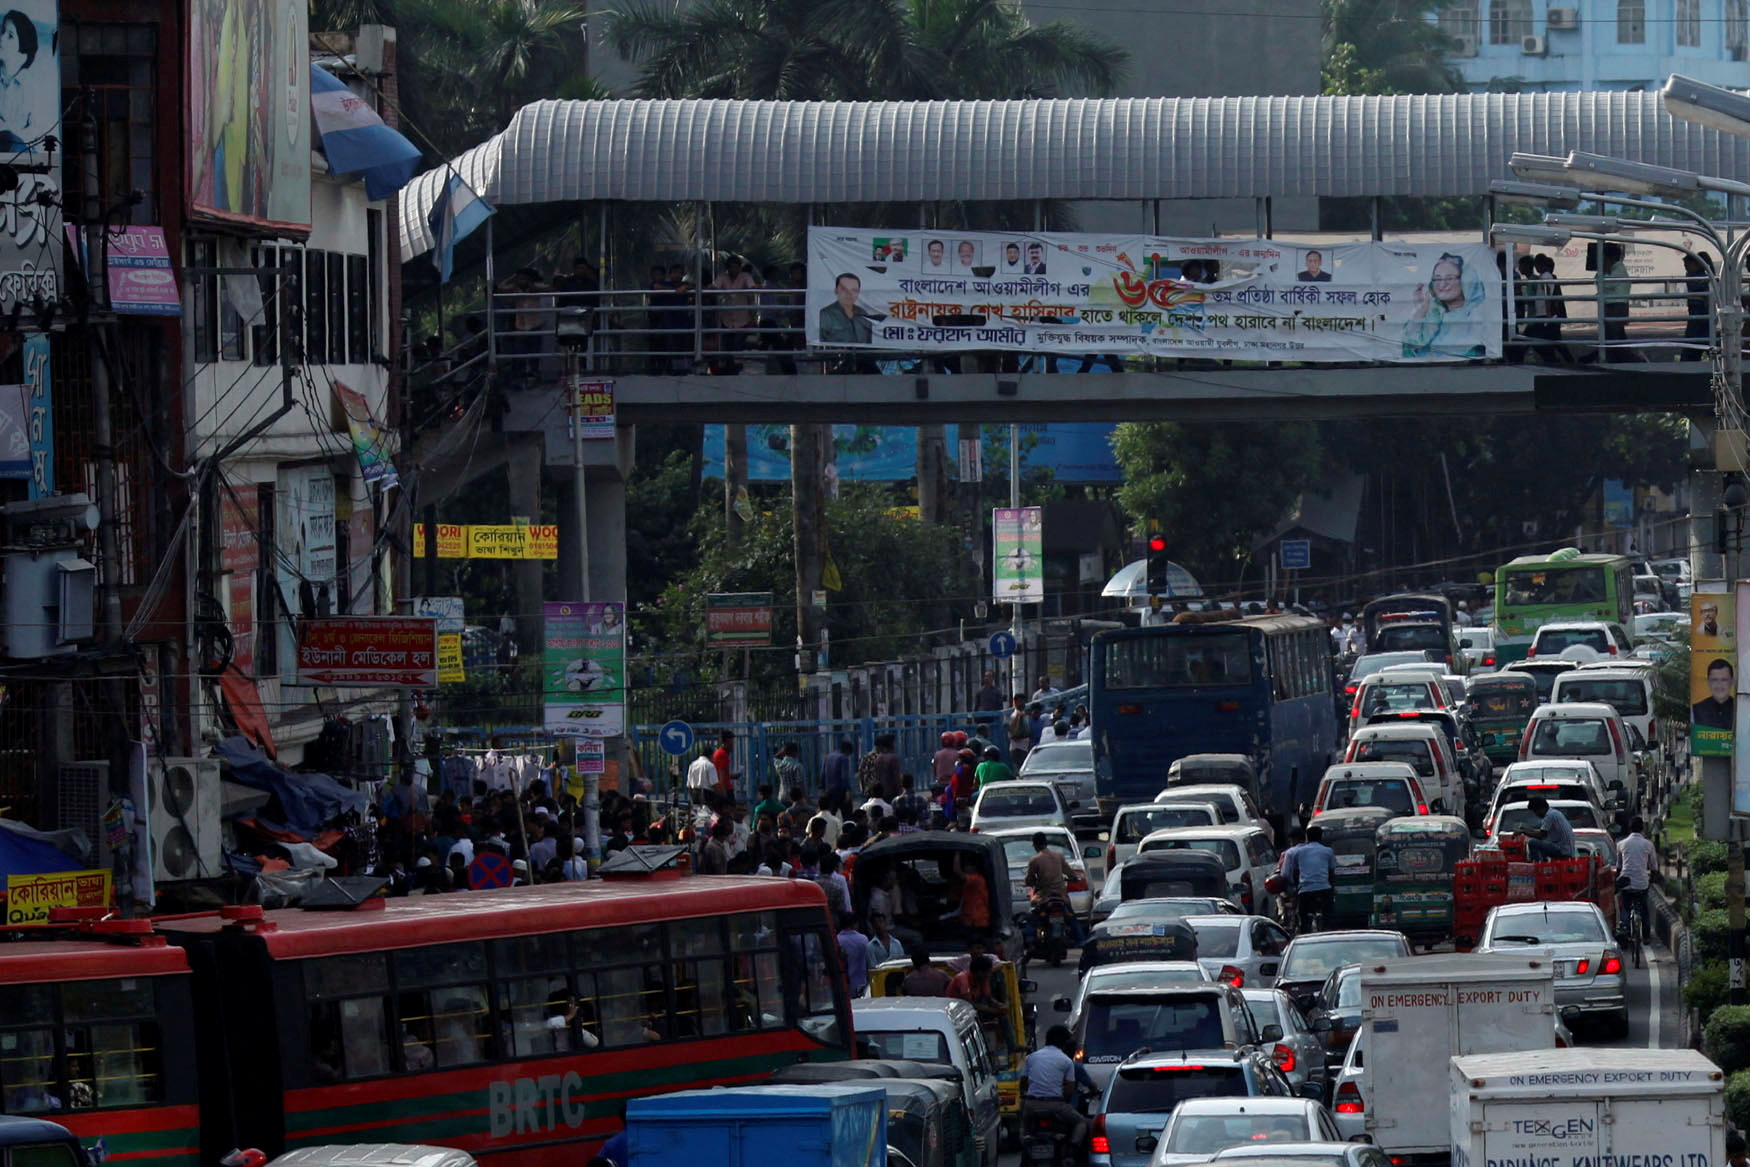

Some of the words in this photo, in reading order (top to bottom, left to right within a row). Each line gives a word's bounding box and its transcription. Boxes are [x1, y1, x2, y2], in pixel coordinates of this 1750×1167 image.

[898, 278, 967, 296] বাংলাদেশ
[1067, 284, 1091, 298] এর
[1211, 291, 1233, 304] তম
[1236, 284, 1275, 305] প্রতিষ্ঠা
[1280, 285, 1321, 305] বার্ষিকী
[1326, 290, 1357, 305] সফল
[1363, 291, 1392, 306] হোক
[970, 302, 1004, 321] শেখ
[1080, 309, 1113, 325] হাতে
[1118, 310, 1162, 326] থাকলে
[1207, 314, 1229, 329] পথ
[1234, 314, 1277, 331] হারাবে
[1282, 316, 1297, 332] না
[976, 326, 1027, 346] আমীর
[474, 529, 526, 543] কোরিয়ান
[301, 645, 347, 665] ইউনানী
[352, 646, 407, 665] মেডিকেল
[411, 651, 432, 669] হল
[9, 876, 78, 905] কোরিয়ান
[1371, 993, 1385, 1009] ON
[1388, 992, 1449, 1008] EMERGENCY
[1458, 991, 1502, 1004] EXPORT
[1509, 990, 1541, 1003] DUTY
[1510, 1075, 1525, 1086] ON
[1528, 1073, 1599, 1085] EMERGENCY
[1604, 1071, 1653, 1083] EXPORT
[1661, 1070, 1692, 1082] DUTY
[490, 1070, 586, 1138] BRTC
